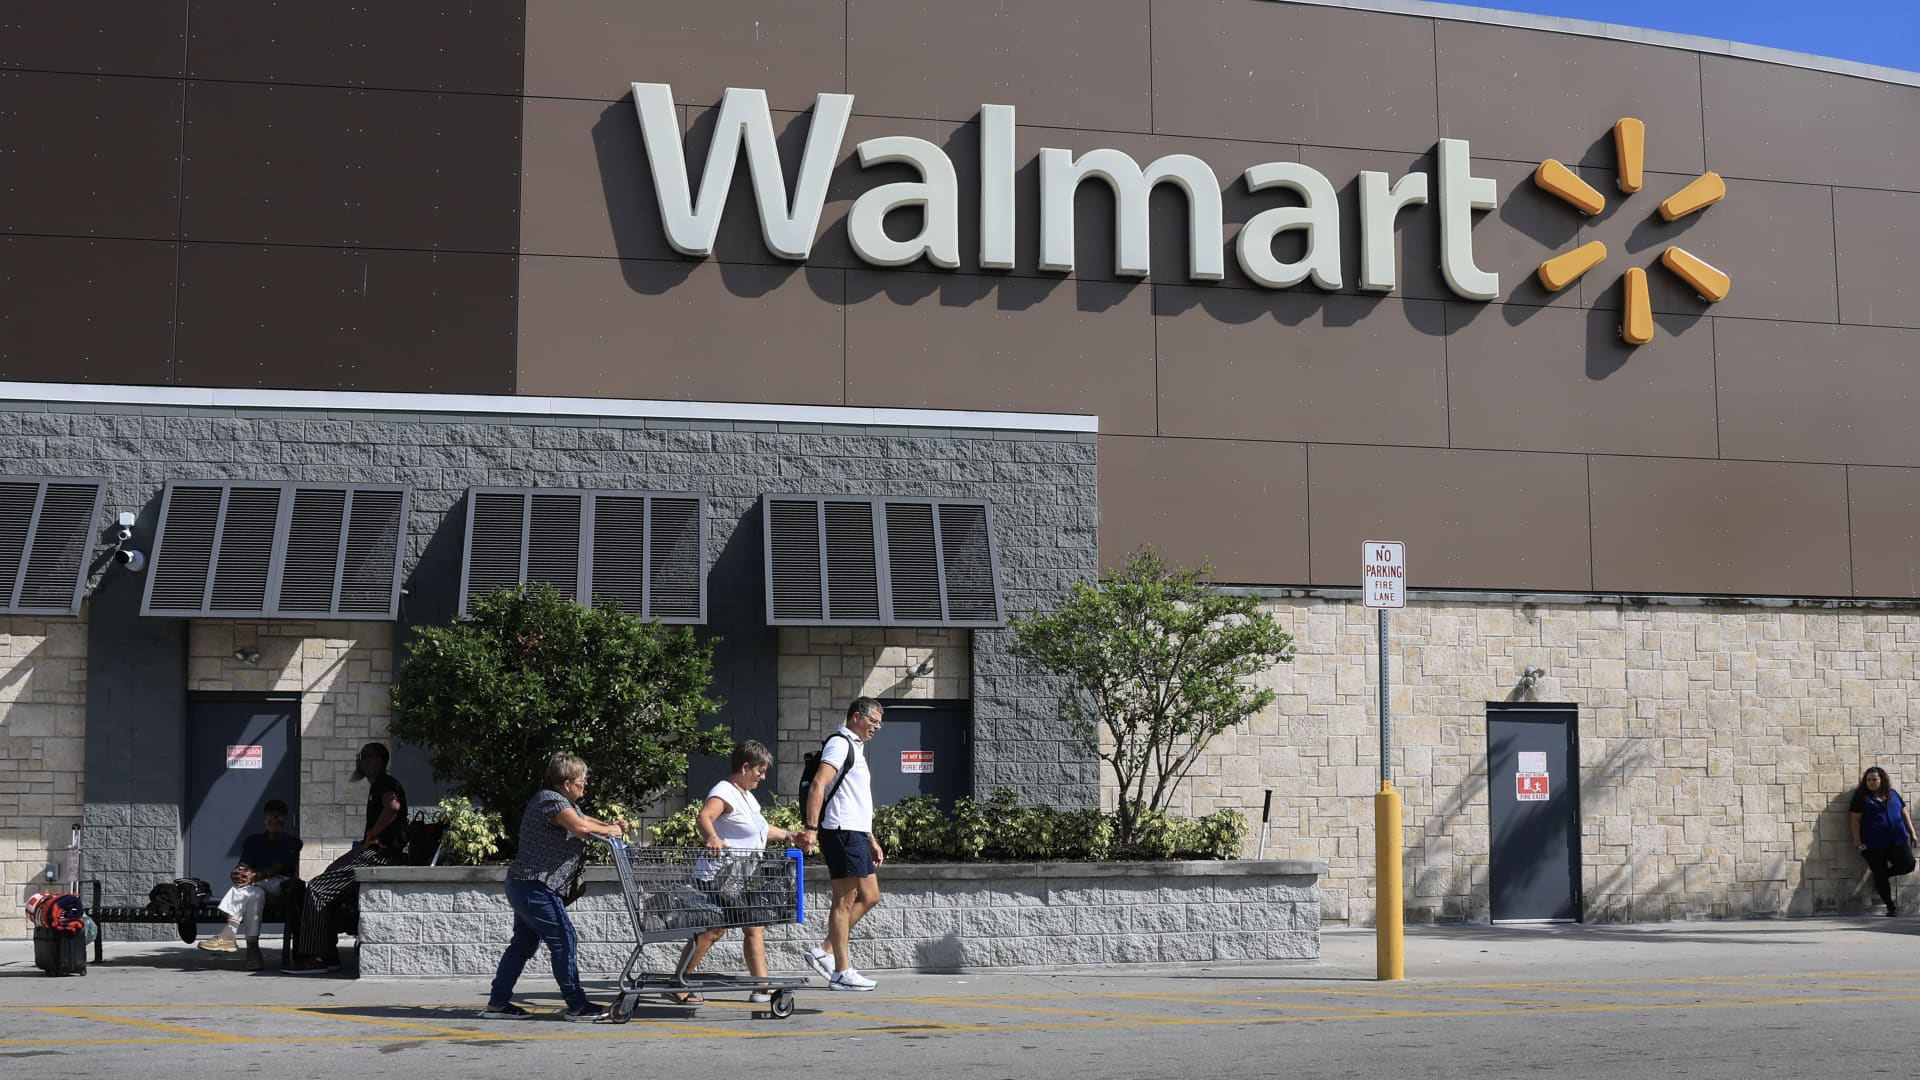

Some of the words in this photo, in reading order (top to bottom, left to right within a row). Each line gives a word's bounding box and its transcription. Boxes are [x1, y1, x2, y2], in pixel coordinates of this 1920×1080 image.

[630, 81, 1500, 301] Walmart
[1376, 549, 1392, 562] NO
[1366, 565, 1402, 578] PARKING
[1375, 581, 1393, 589] FIRE
[1374, 592, 1395, 601] LANE
